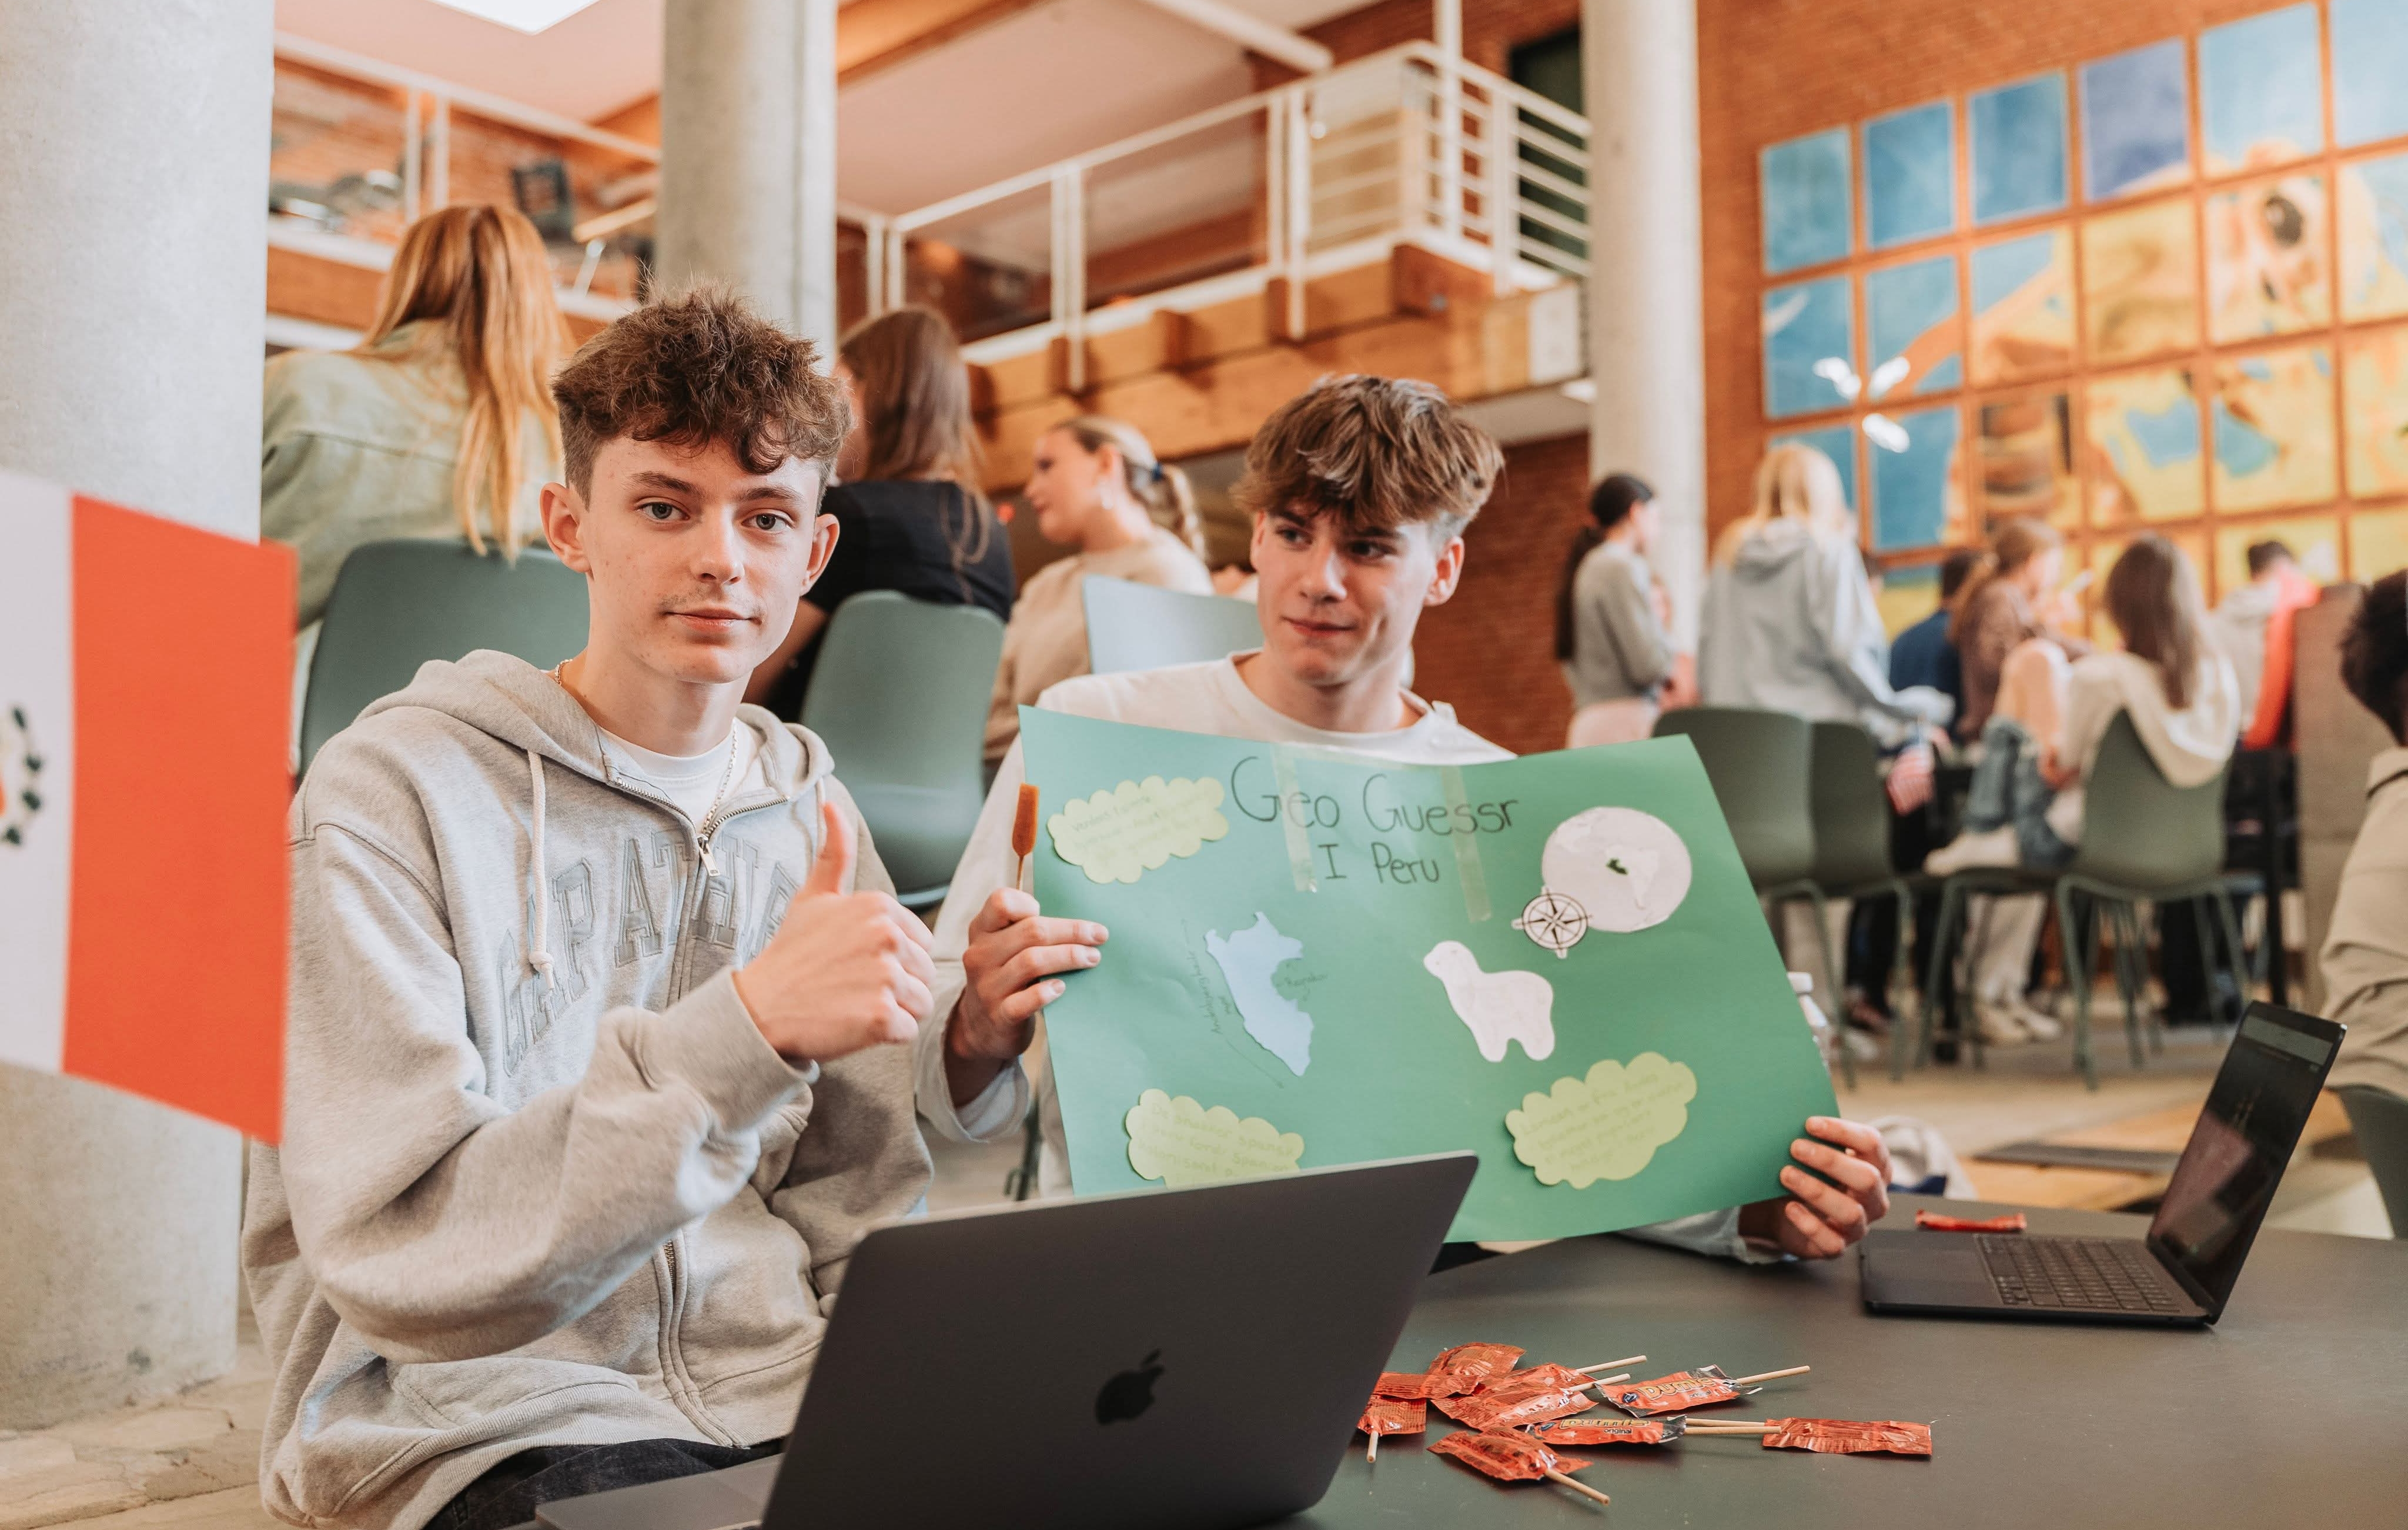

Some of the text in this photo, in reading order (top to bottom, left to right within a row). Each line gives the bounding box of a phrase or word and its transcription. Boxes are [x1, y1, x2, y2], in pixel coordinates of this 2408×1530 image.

[1231, 756, 1340, 829] Geo
[1363, 773, 1520, 836] Guessr
[1317, 842, 1440, 884] I Peru
[1637, 1377, 1716, 1400] Dumle
[1603, 1427, 1633, 1435] original
